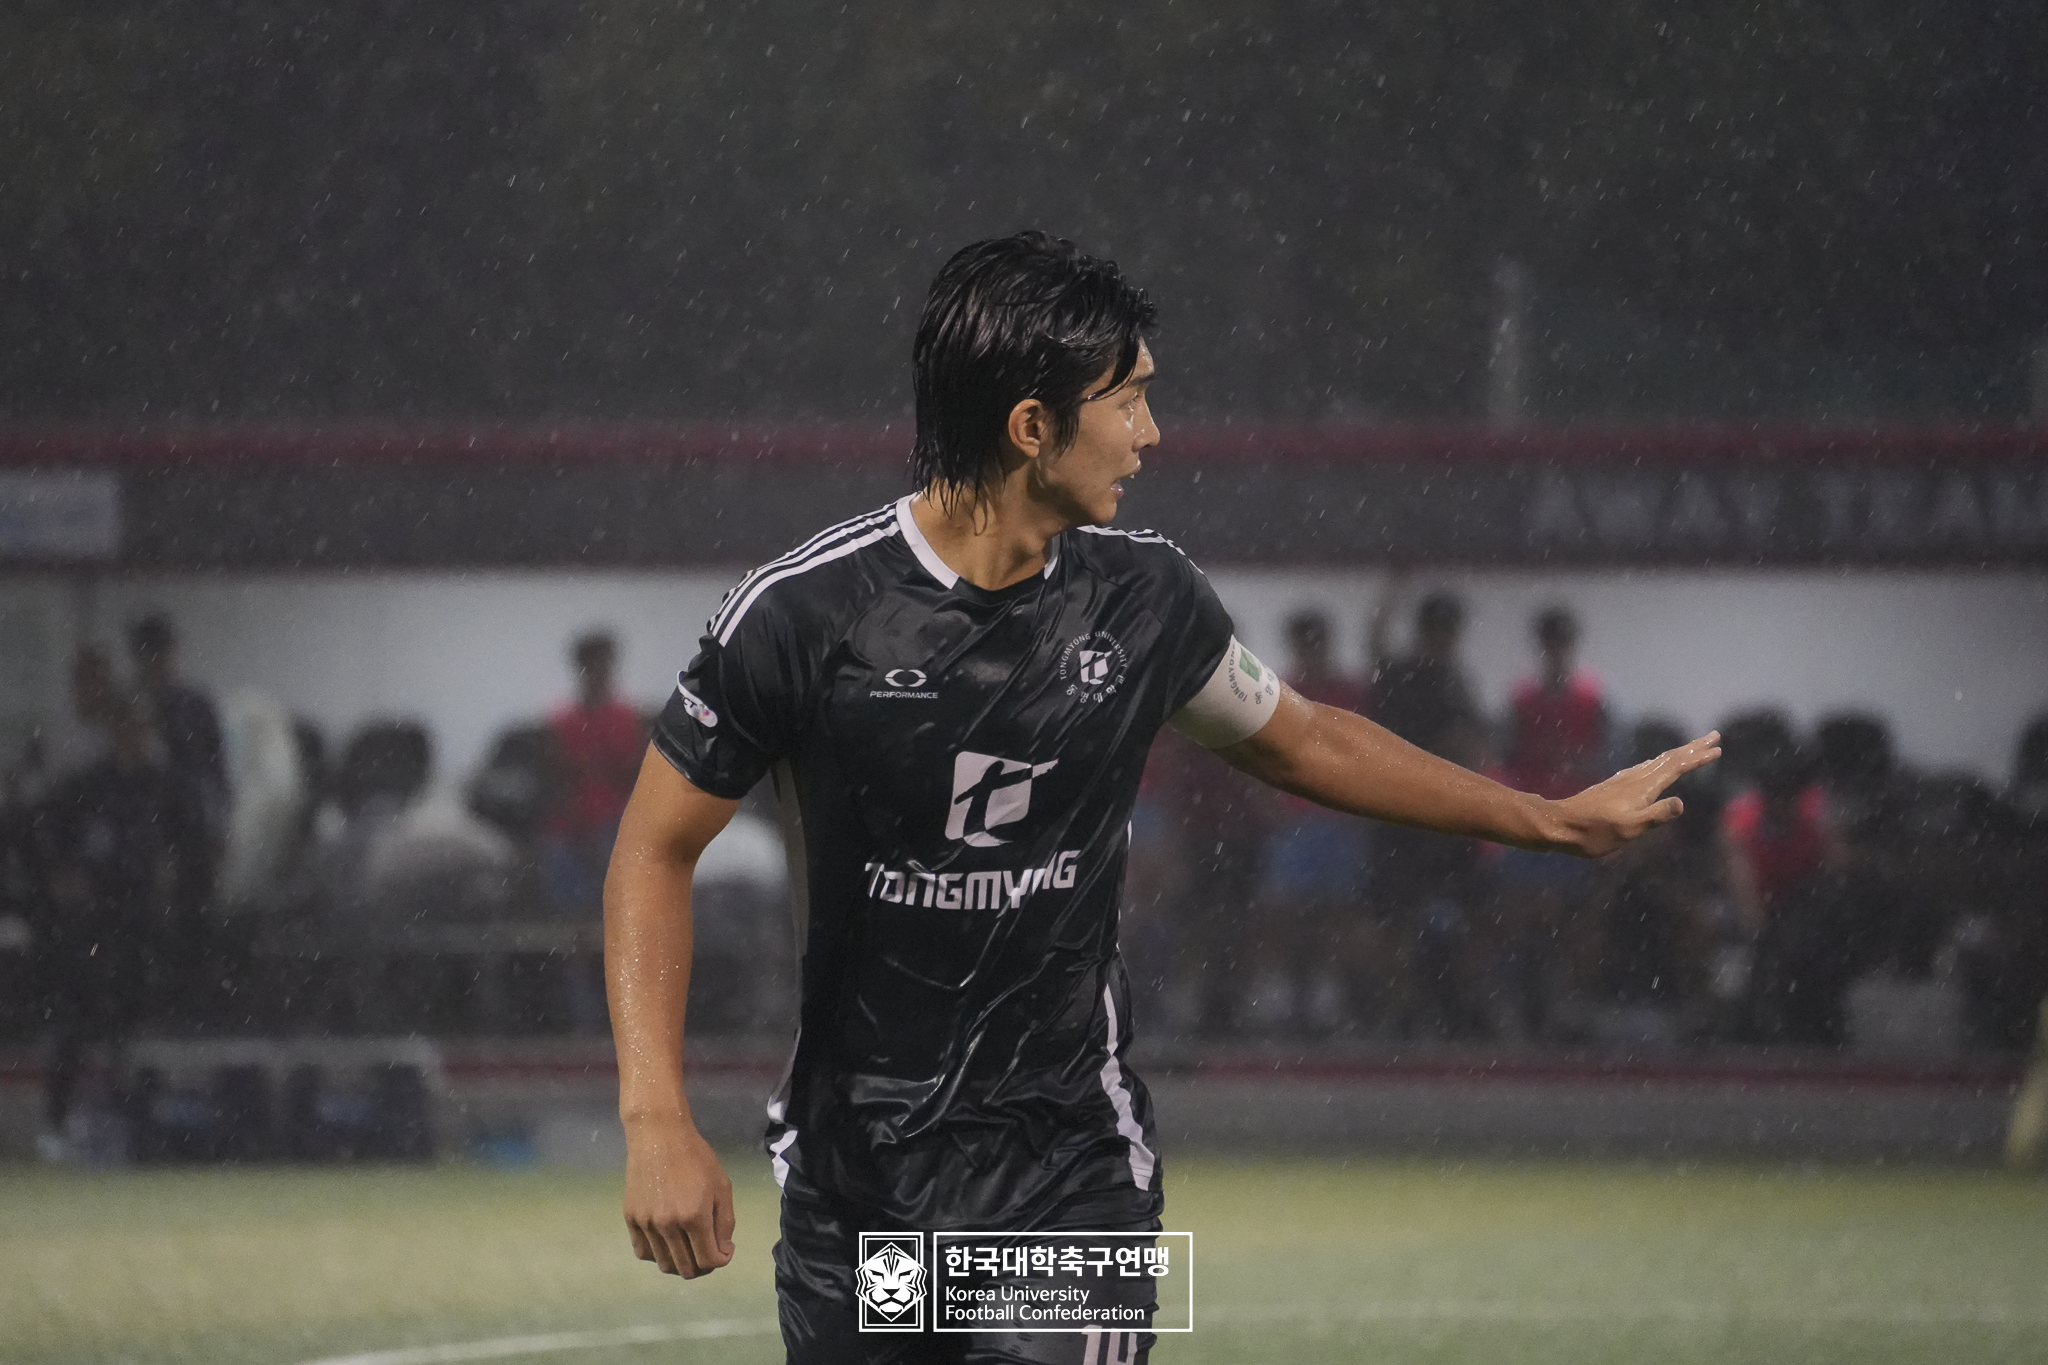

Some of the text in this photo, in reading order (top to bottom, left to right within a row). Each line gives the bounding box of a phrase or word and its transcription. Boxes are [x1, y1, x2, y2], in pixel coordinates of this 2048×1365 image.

[1525, 468, 1785, 542] AWAY
[1060, 630, 1128, 680] TONGMYONG UNIVERSITY
[869, 690, 939, 699] PERFORMANCE
